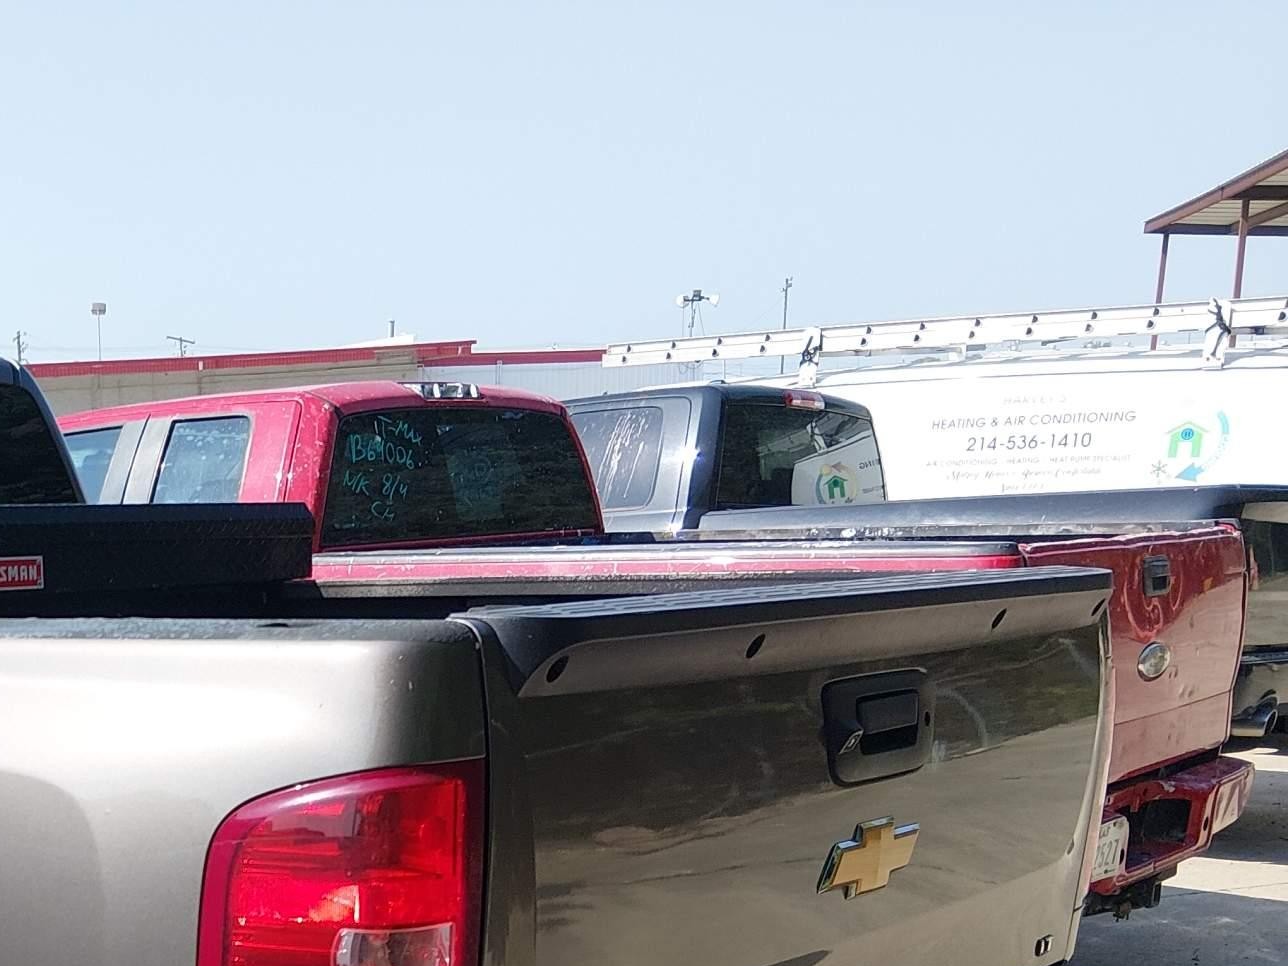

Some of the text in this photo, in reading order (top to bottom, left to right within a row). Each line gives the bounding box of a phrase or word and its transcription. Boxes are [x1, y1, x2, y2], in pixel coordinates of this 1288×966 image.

[931, 410, 1137, 430] HEATING & AIR CONDITIONING
[966, 432, 1092, 451] 214-536-1410
